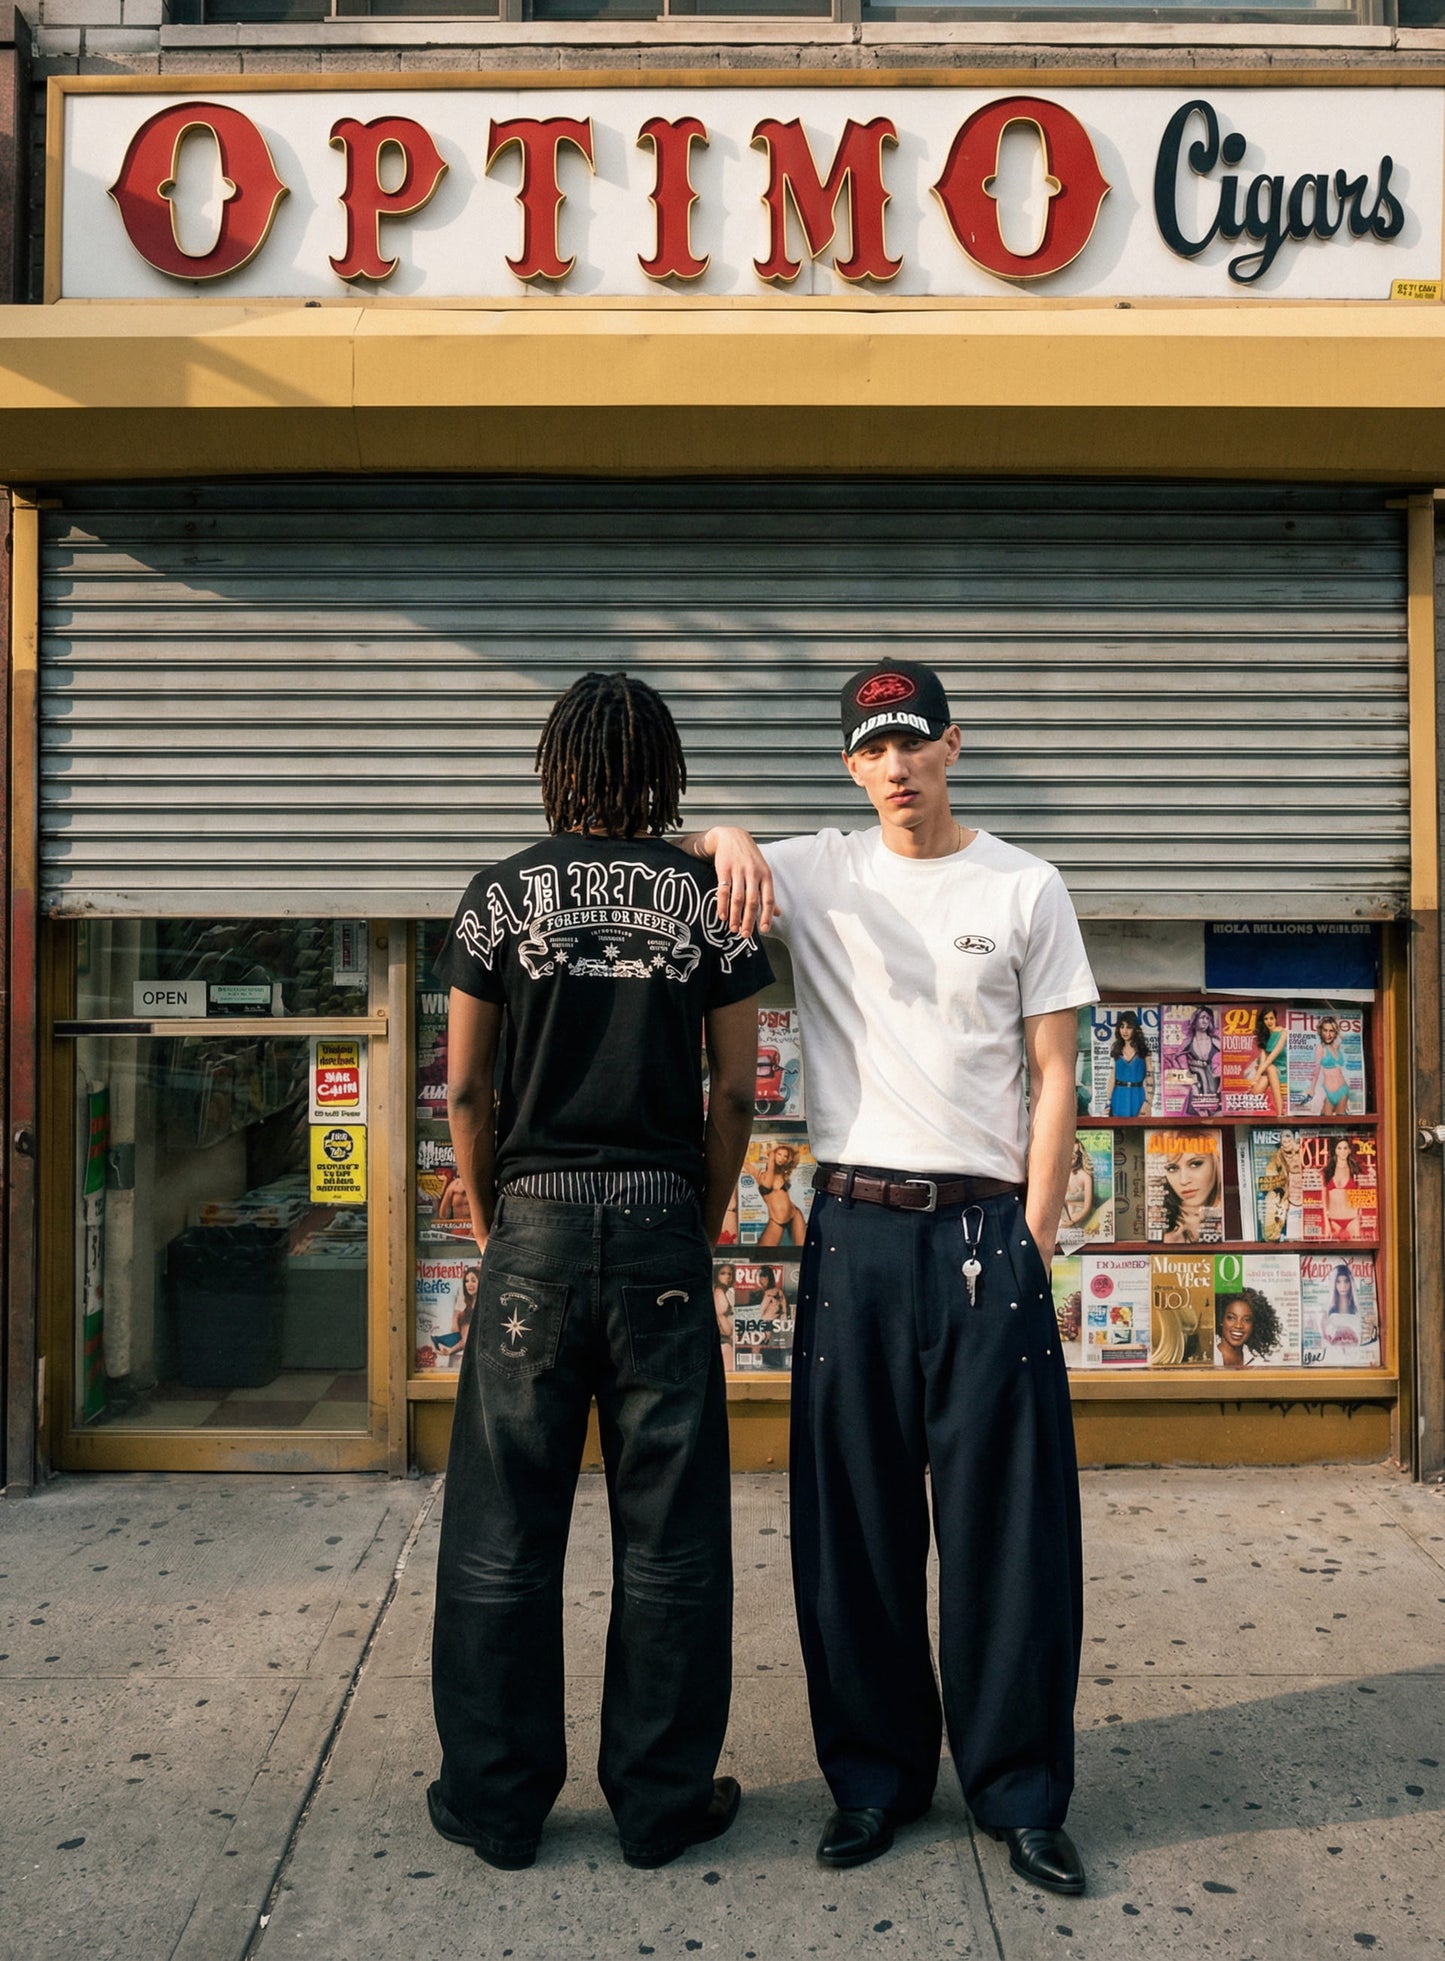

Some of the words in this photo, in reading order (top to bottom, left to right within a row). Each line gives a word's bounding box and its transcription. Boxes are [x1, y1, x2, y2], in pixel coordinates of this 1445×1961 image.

[106, 96, 1112, 284] OPTIMO
[1154, 99, 1405, 284] Cigars
[547, 910, 608, 931] FOREVER
[611, 910, 630, 923] OR
[633, 912, 676, 935] NEVER
[143, 991, 187, 1005] OPEN
[1219, 1256, 1240, 1282] O
